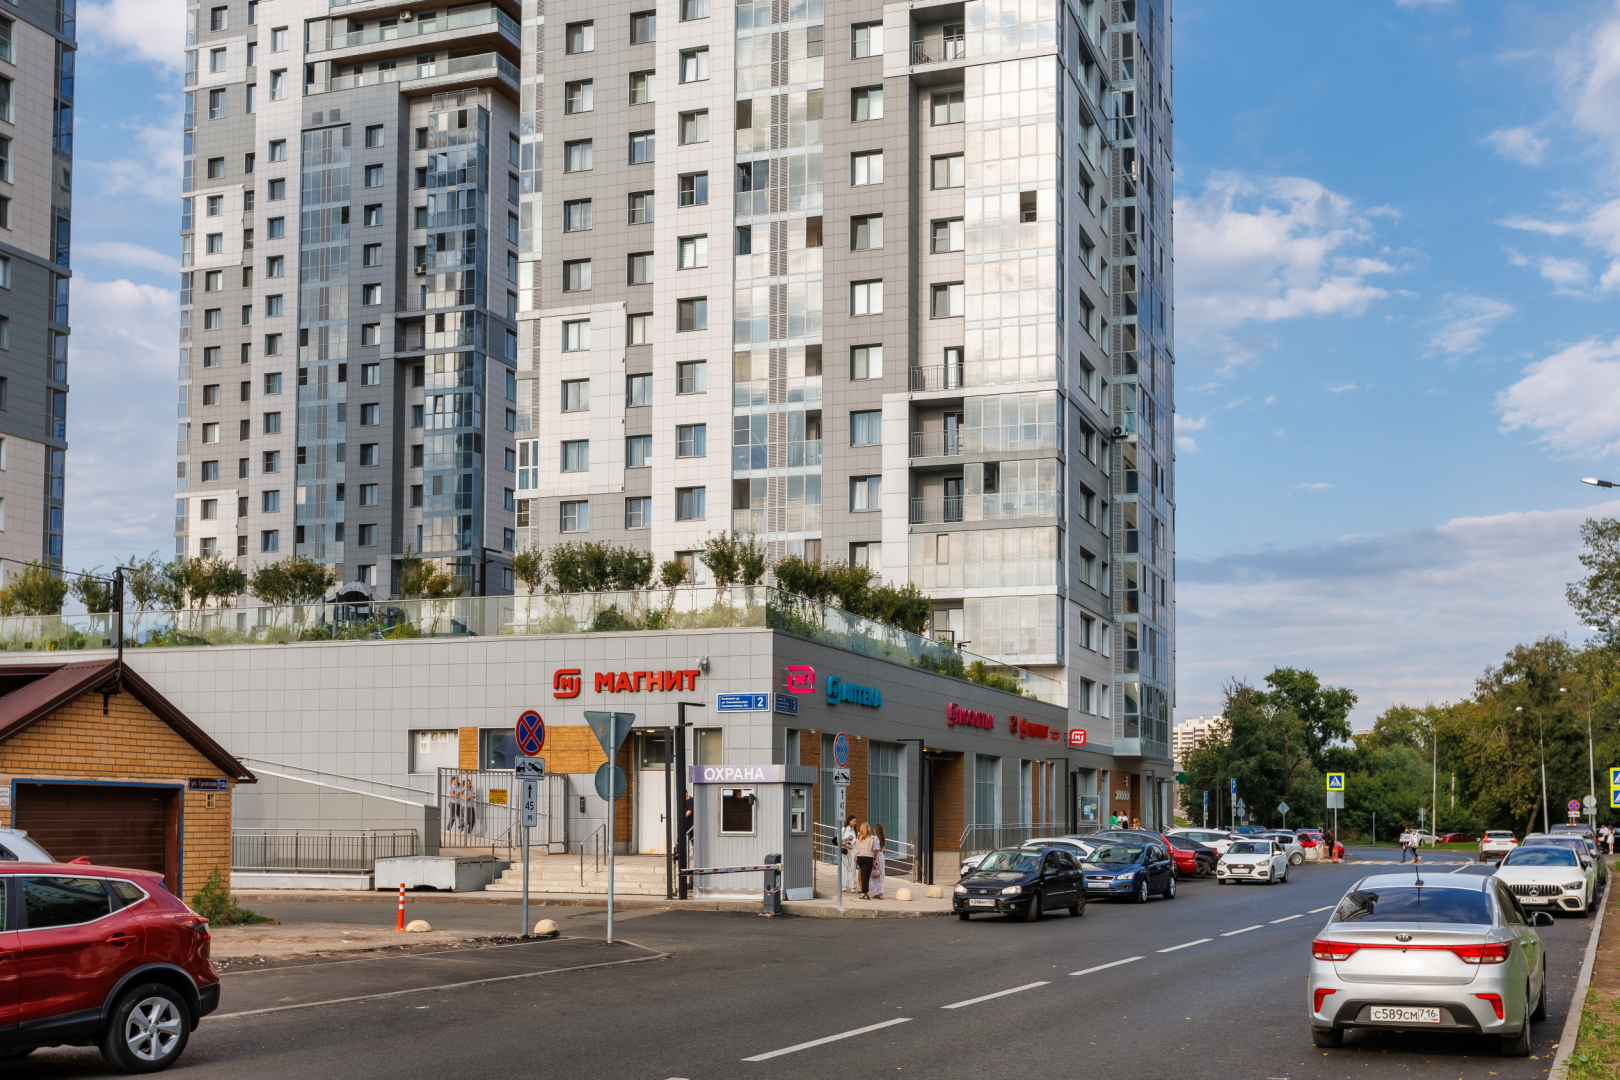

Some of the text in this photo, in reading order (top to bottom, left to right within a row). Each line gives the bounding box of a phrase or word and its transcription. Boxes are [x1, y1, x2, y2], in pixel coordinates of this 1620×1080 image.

[595, 670, 700, 692] МАГНИТ
[842, 682, 882, 707] АПТЕКА
[757, 697, 764, 707] 2
[793, 701, 796, 710] 2
[957, 708, 994, 729] КОСМЕТИК
[704, 767, 765, 780] ОХРАНА
[525, 801, 534, 810] 45
[839, 801, 845, 809] 45
[1374, 1008, 1436, 1020] С589СМ 716
